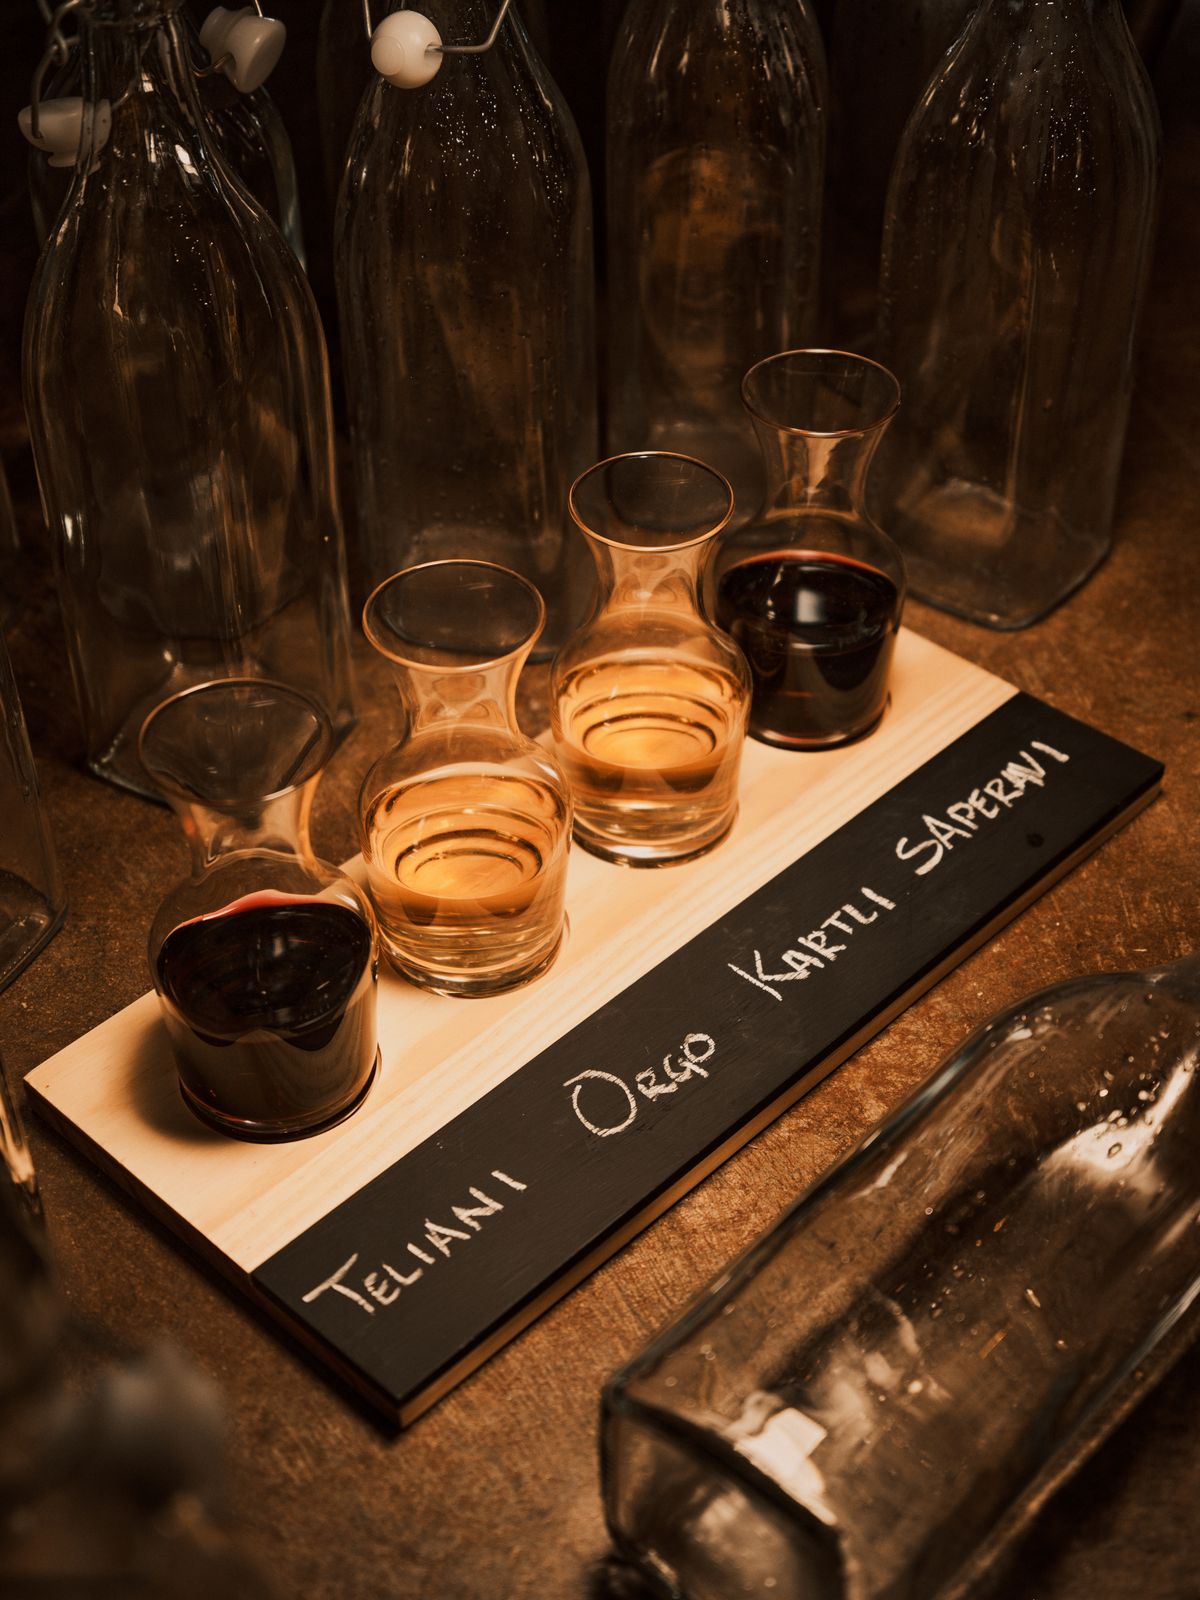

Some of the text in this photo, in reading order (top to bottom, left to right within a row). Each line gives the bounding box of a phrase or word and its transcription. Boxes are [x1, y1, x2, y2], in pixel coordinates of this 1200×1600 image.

[302, 740, 1070, 1313] TELIANI ORGO KARTLI SAPERAVI
